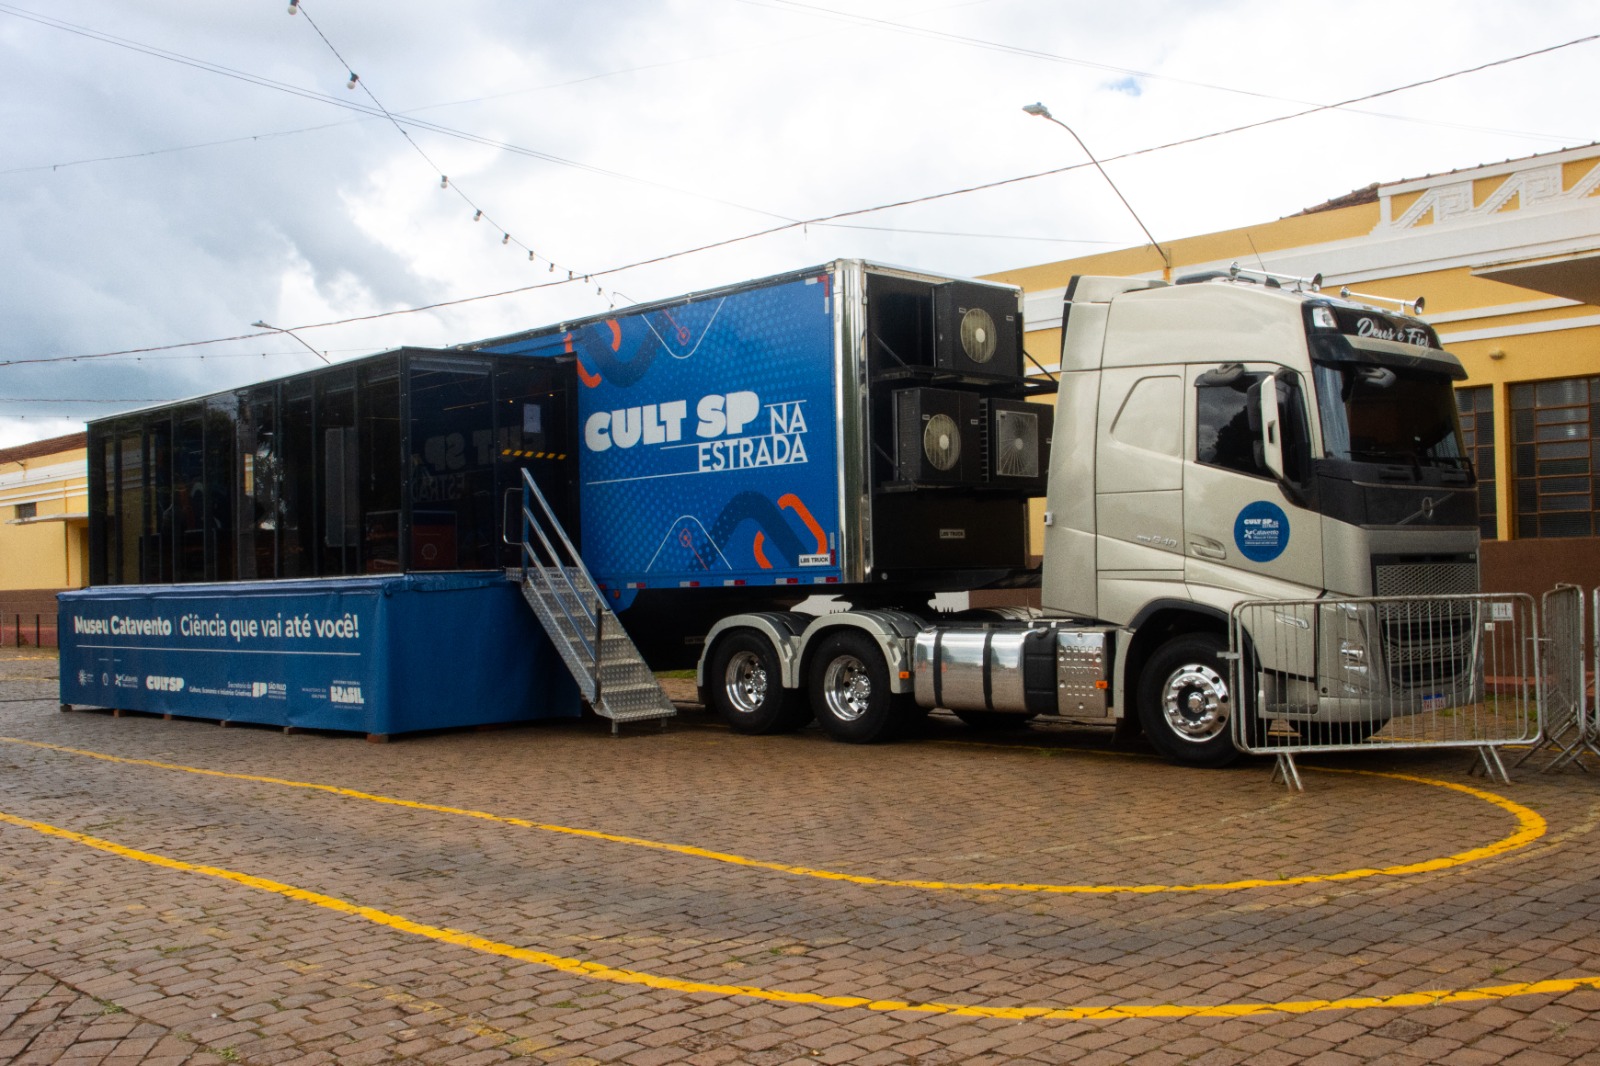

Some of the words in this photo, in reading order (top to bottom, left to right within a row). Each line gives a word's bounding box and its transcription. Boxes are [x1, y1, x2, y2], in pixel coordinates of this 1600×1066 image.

[1357, 317, 1395, 341] Deus
[1405, 328, 1430, 348] Fiel
[584, 400, 687, 452] CULT
[696, 391, 760, 438] SP
[770, 401, 808, 435] NA
[698, 434, 808, 472] ESTRADA
[74, 615, 109, 635] Museu
[110, 615, 173, 636] Catavento
[180, 612, 227, 637] Ciência
[230, 618, 258, 643] que
[261, 612, 282, 638] vai
[285, 613, 312, 638] até
[314, 613, 360, 639] você!
[330, 686, 365, 704] BRASIL
